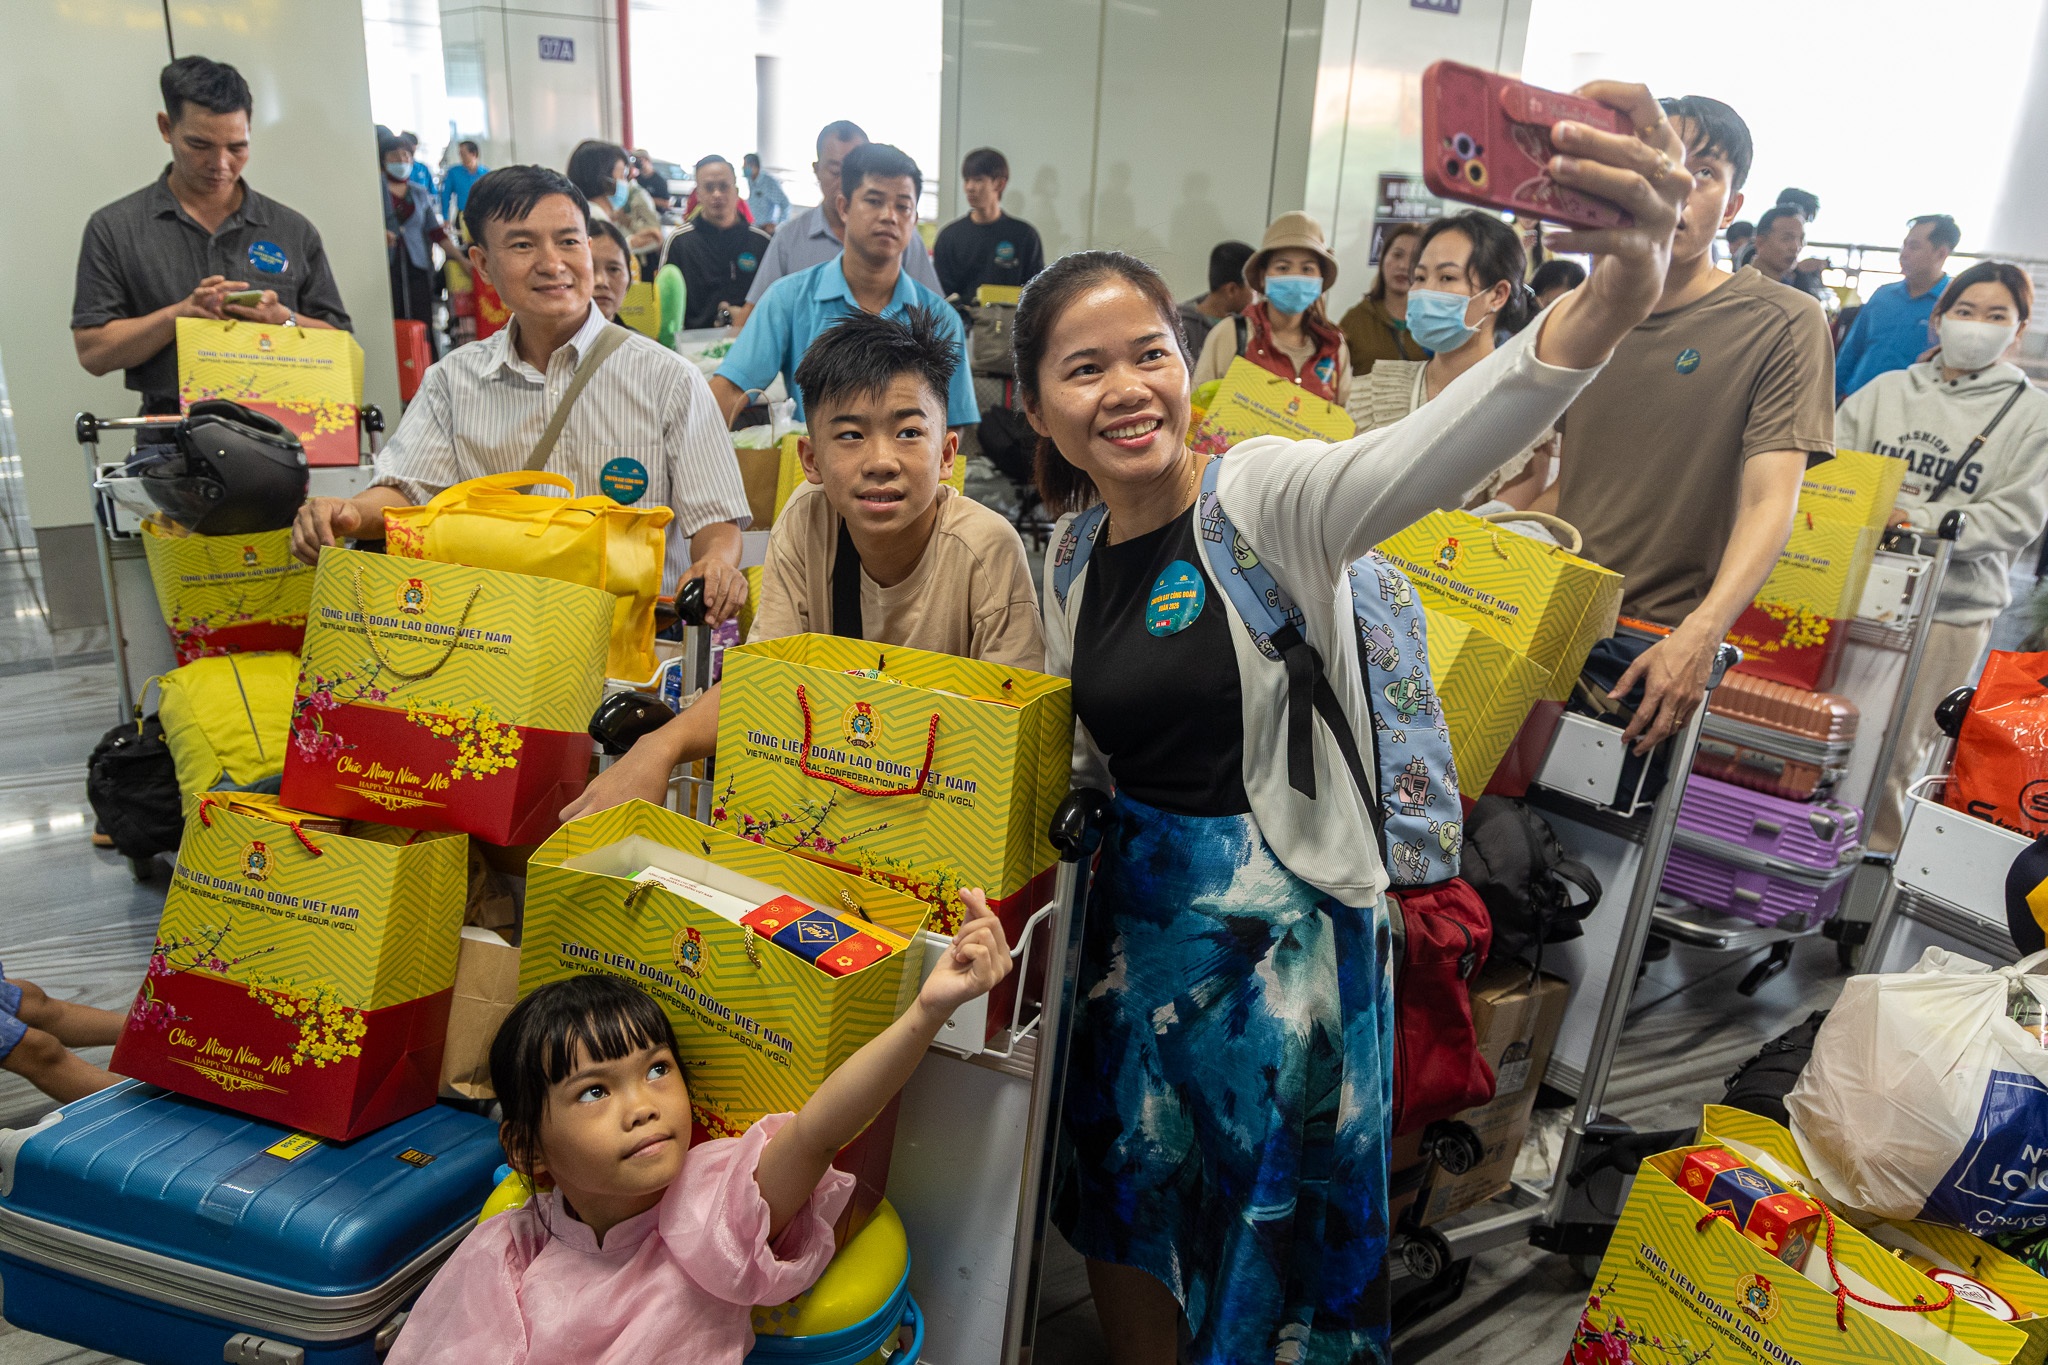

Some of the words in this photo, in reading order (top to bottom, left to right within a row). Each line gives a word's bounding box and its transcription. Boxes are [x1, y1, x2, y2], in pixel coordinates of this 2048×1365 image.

[1898, 430, 1950, 454] FASHION
[1497, 599, 1520, 616] NAM
[379, 630, 441, 647] CONFEDERATION
[401, 619, 422, 631] LAO
[485, 631, 512, 645] NAM
[336, 755, 362, 773] Chúc
[395, 767, 421, 785] Năm
[745, 748, 782, 764] VIETNAM
[784, 754, 822, 773] GENRAL
[824, 765, 895, 790] CONFEDERATION
[947, 795, 977, 810] (VGCL)
[849, 753, 873, 770] LAO
[876, 759, 911, 779] ĐỘNG
[945, 775, 977, 795] NAM
[359, 780, 382, 792] HAPPY
[383, 785, 402, 795] NEW
[402, 788, 424, 799] YEAR
[190, 886, 221, 903] GENERAL
[222, 896, 283, 917] CONFEDERATION
[285, 910, 296, 919] OF
[297, 912, 329, 927] LABOUR
[331, 919, 358, 933] (VGCL)
[244, 886, 264, 900] LAO
[267, 890, 298, 908] ĐỘNG
[302, 897, 327, 915] VIỆT
[330, 903, 360, 920] NAM
[559, 959, 604, 976] VIETNAM
[651, 985, 715, 1027] CONFEDERATION
[716, 1021, 728, 1033] OF
[729, 1028, 763, 1052] LABOUR
[764, 1046, 792, 1069] (VGCL)
[560, 941, 600, 961] TỔNG
[603, 952, 636, 972] LIÊN
[638, 963, 674, 989] ĐOÀN
[675, 979, 697, 1002] LAO
[698, 990, 732, 1021] ĐỘNG
[734, 1011, 762, 1037] VIỆT
[763, 1030, 794, 1054] NAM
[168, 1027, 198, 1048] Chúc
[234, 1046, 263, 1066] Năm
[194, 1055, 221, 1071] HAPPY
[221, 1063, 241, 1076] NEW
[241, 1068, 265, 1083] YEAR
[1634, 1256, 1667, 1289] VIETNAM
[1668, 1286, 1704, 1320] GENERAL
[1639, 1242, 1668, 1274] TỔNG
[1669, 1267, 1696, 1297] LIÊN
[1696, 1287, 1734, 1325] ĐOÀN
[1734, 1317, 1762, 1344] LAO
